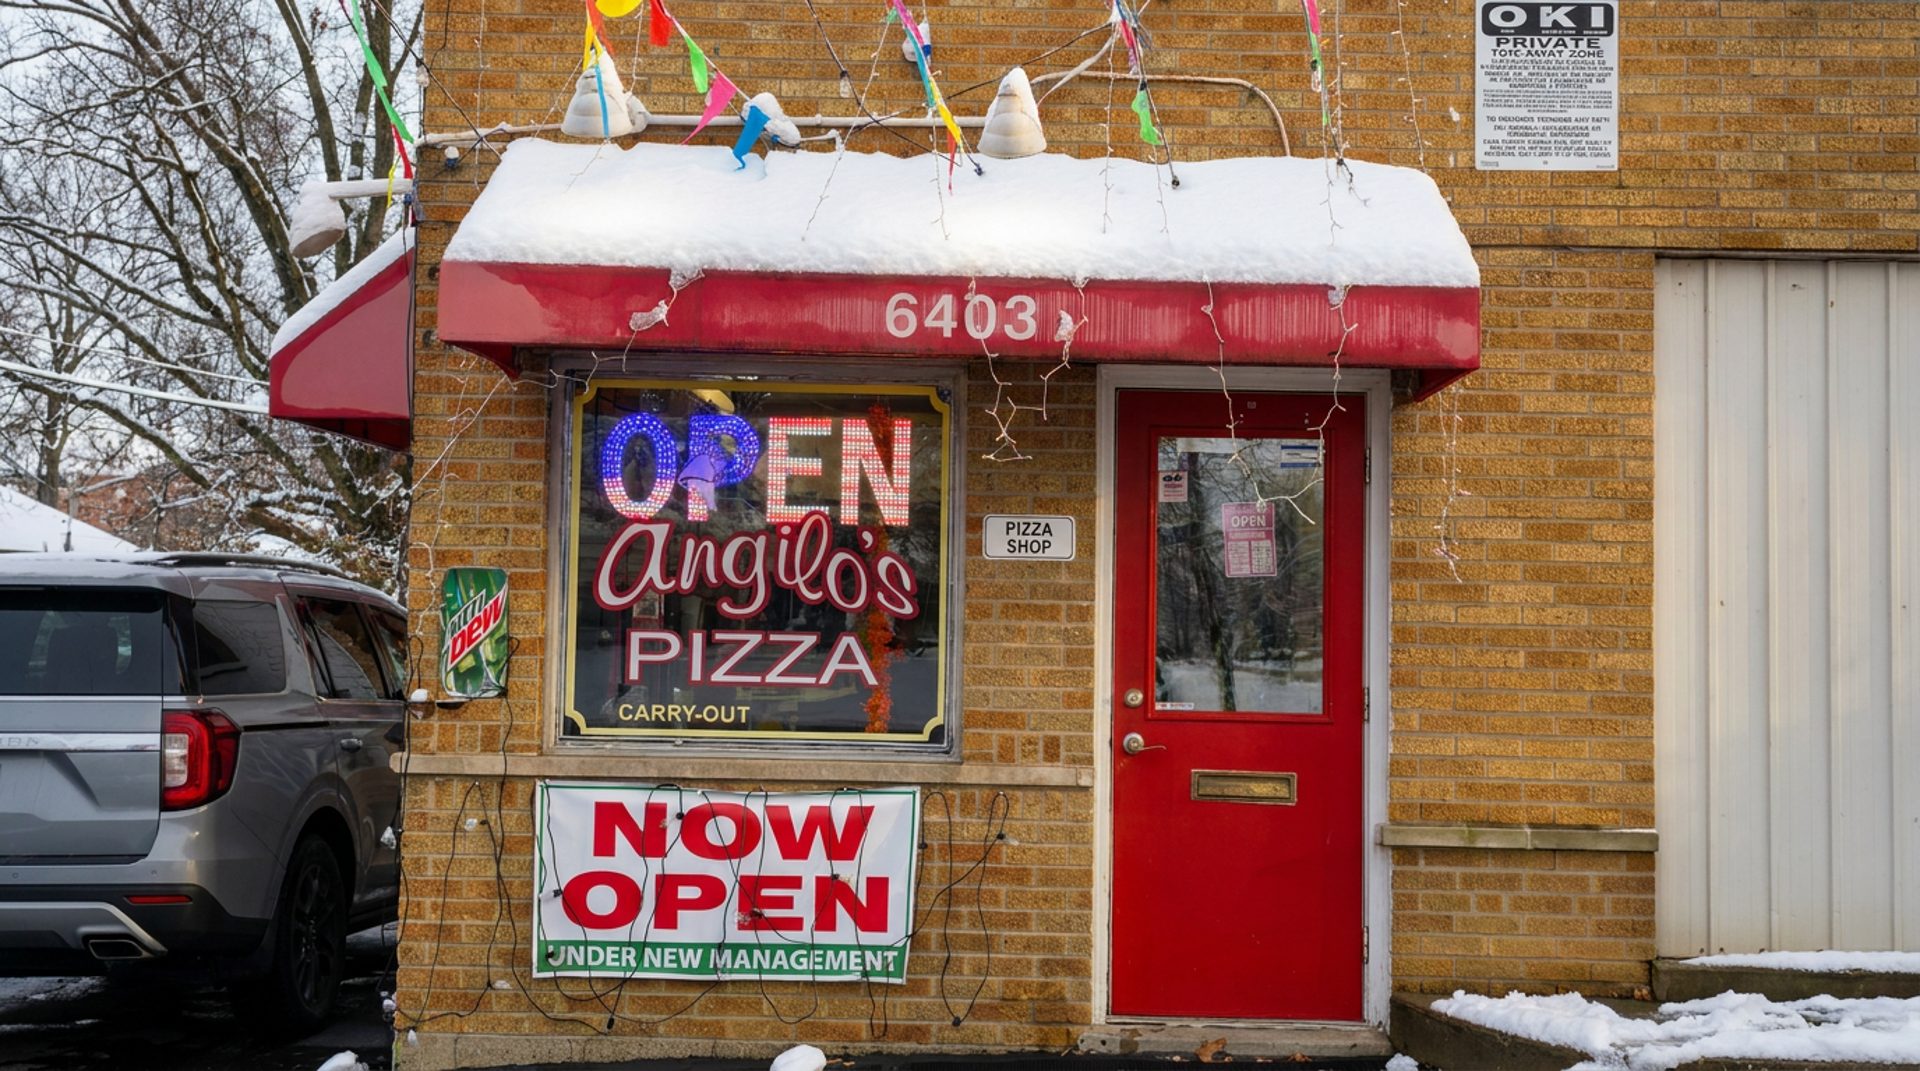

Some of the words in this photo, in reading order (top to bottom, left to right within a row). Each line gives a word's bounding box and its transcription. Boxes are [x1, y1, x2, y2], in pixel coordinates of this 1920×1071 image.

[1489, 5, 1604, 27] OKI
[1496, 37, 1600, 49] PRIVATE
[886, 292, 1036, 340] 6403
[602, 412, 912, 526] OPEN
[1006, 521, 1053, 537] PIZZA
[1231, 515, 1267, 528] OPEN
[1007, 538, 1052, 554] SHOP
[626, 629, 881, 688] PIZZA
[618, 703, 750, 723] CARRY-OUT
[593, 801, 875, 861] NOW
[562, 870, 890, 933] OPEN
[547, 944, 637, 967] UNDER
[643, 946, 703, 968] NEW
[709, 947, 898, 972] MANAGEMENT
